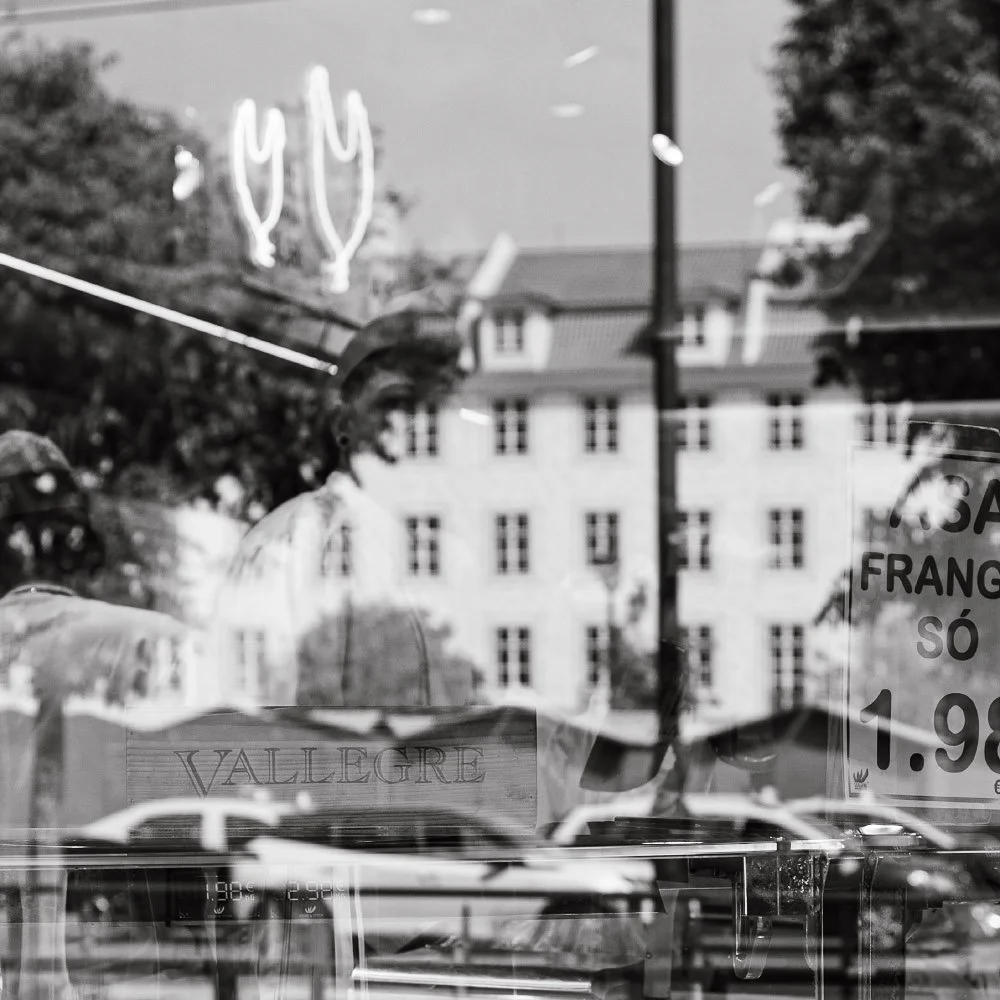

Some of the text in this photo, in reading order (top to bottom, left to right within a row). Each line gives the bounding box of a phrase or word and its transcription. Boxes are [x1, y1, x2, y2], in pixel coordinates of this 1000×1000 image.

[916, 608, 979, 662] SÓ
[173, 746, 487, 798] VALLEGRE
[205, 881, 243, 901] 1.98
[287, 881, 333, 901] 2.98
